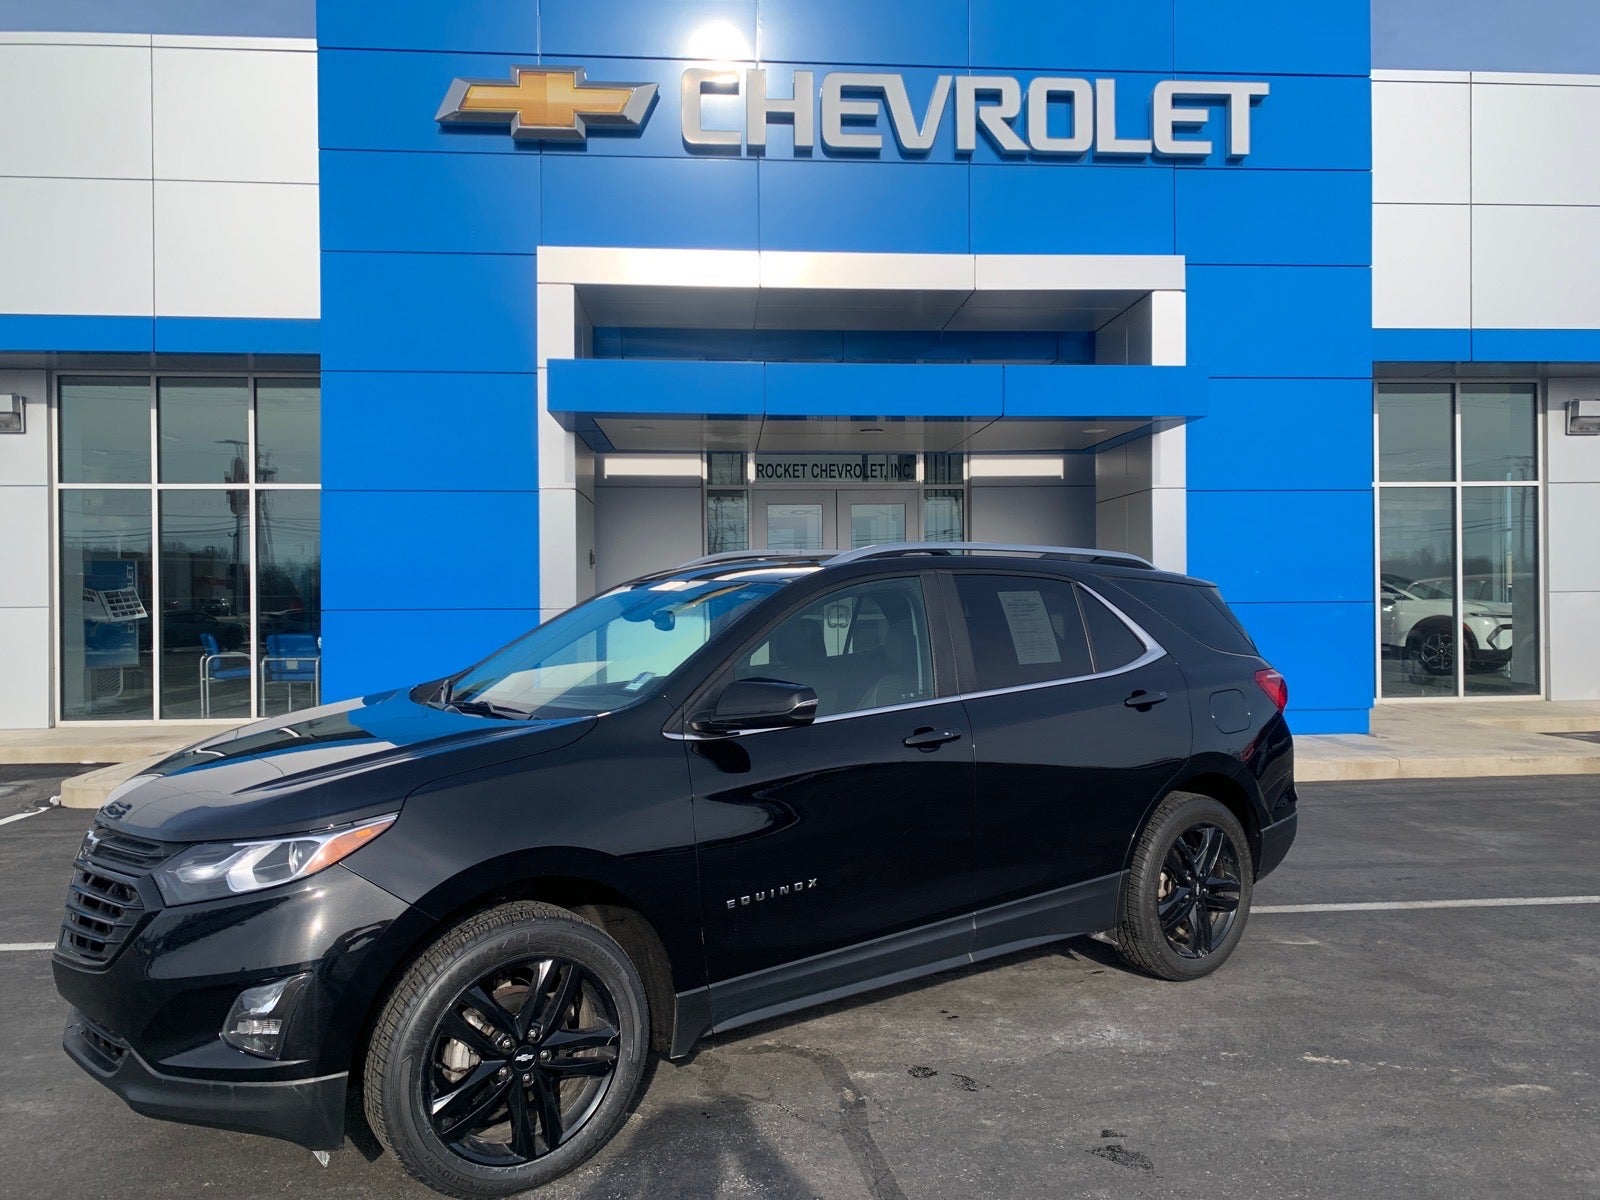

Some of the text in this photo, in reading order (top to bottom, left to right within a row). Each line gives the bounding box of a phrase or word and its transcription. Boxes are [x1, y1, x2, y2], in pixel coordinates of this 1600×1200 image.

[680, 67, 1270, 158] CHEVROLET
[757, 463, 807, 479] ROCKET
[726, 877, 818, 909] EQUINOX
